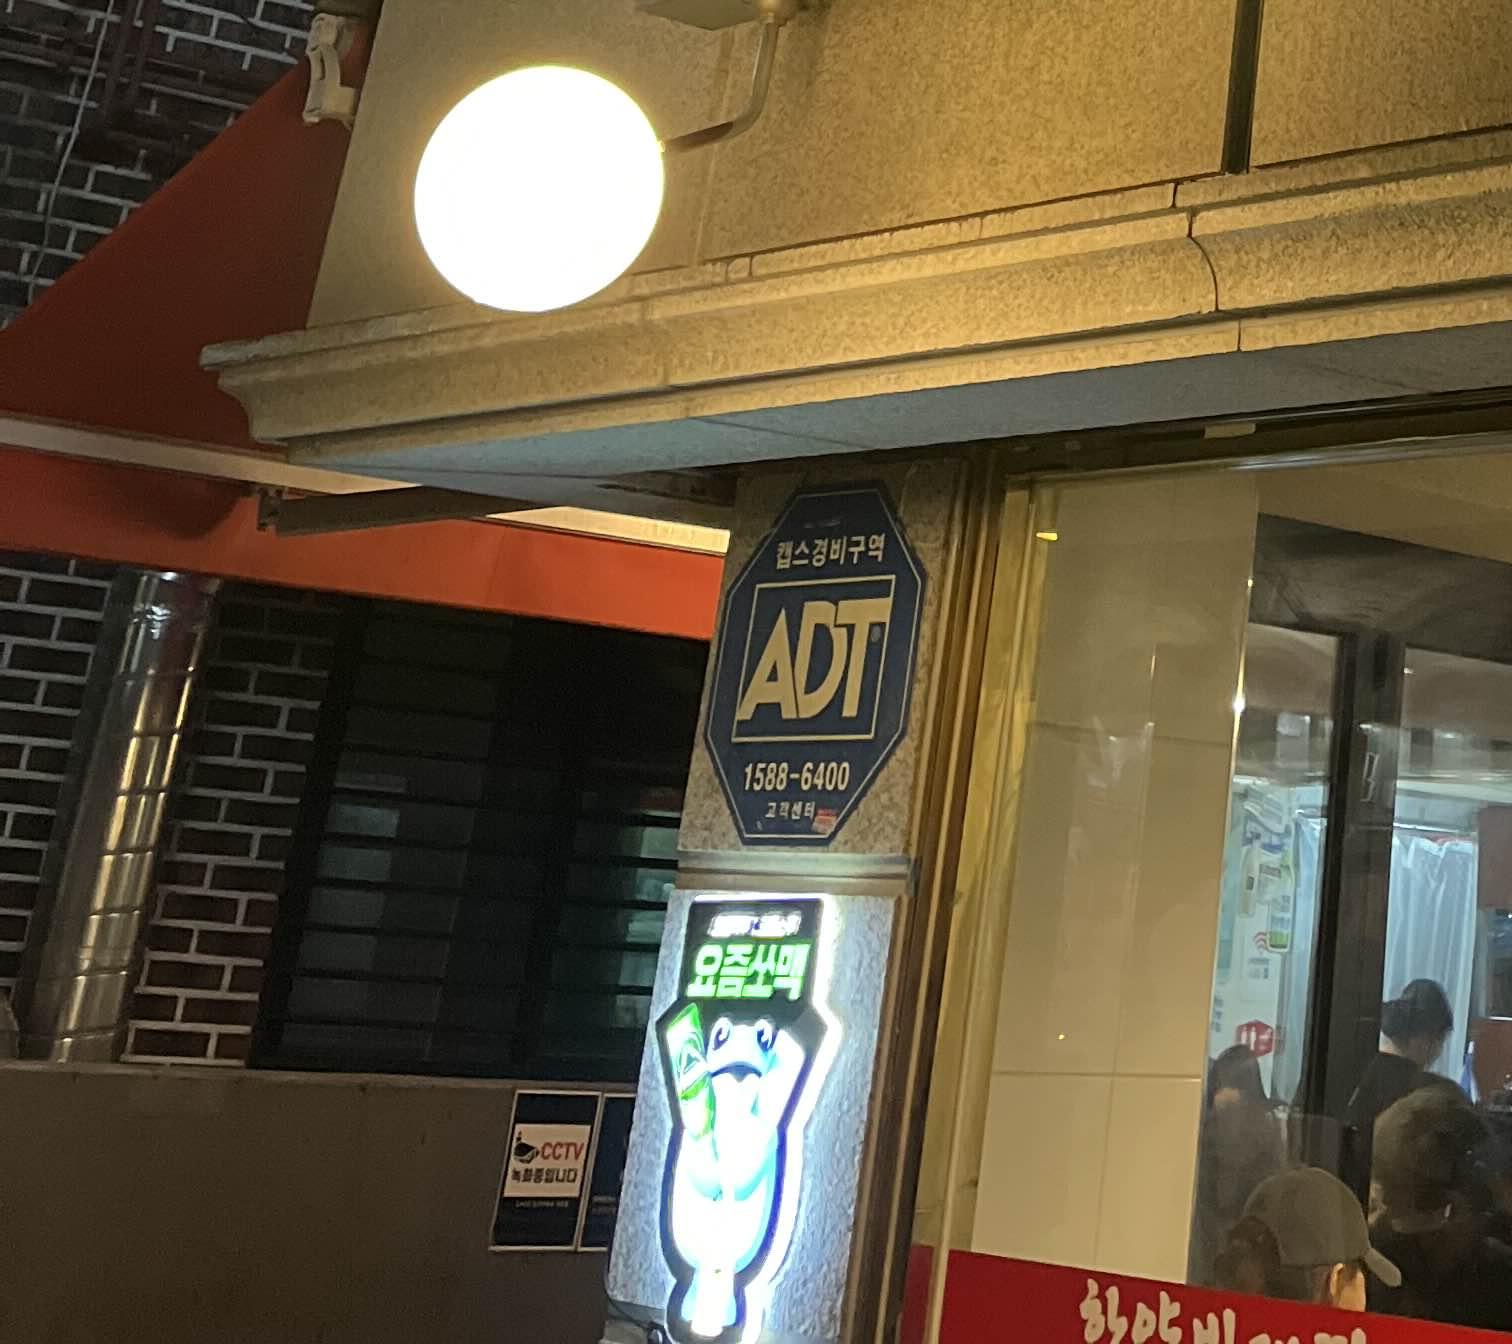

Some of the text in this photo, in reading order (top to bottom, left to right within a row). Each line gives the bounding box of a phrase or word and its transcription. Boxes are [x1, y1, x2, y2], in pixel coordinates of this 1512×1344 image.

[776, 534, 886, 570] 캡스경비구역
[737, 596, 892, 721] ADT
[744, 761, 850, 792] 1588-6400
[765, 800, 816, 820] 고객센터
[541, 1142, 584, 1161] CCTV
[511, 1168, 578, 1184] 녹화중입니다
